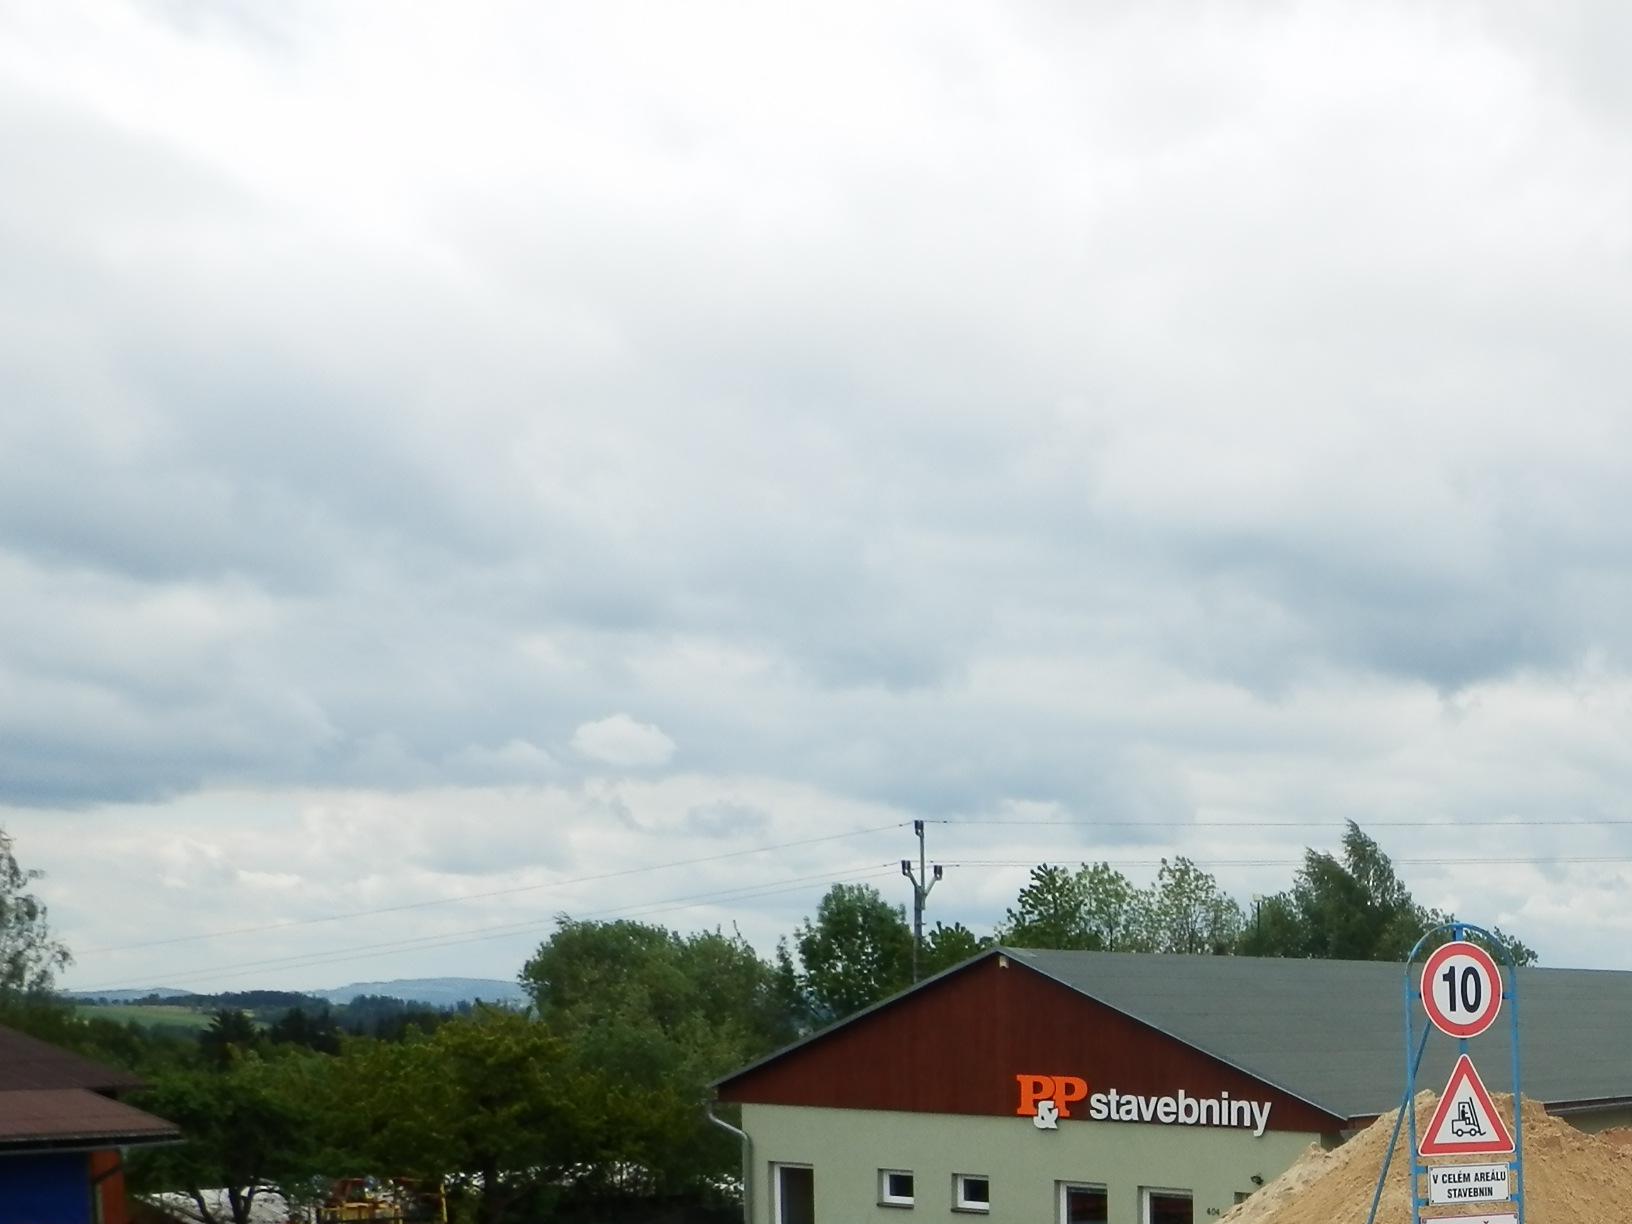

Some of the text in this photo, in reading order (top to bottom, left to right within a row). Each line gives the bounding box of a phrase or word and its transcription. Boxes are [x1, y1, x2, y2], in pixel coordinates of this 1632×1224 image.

[1443, 966, 1481, 1013] 10
[1089, 1088, 1272, 1137] stavebniny
[1432, 1169, 1506, 1184] V CELÉM AREÁLU
[1447, 1187, 1493, 1199] STAVEBNIN
